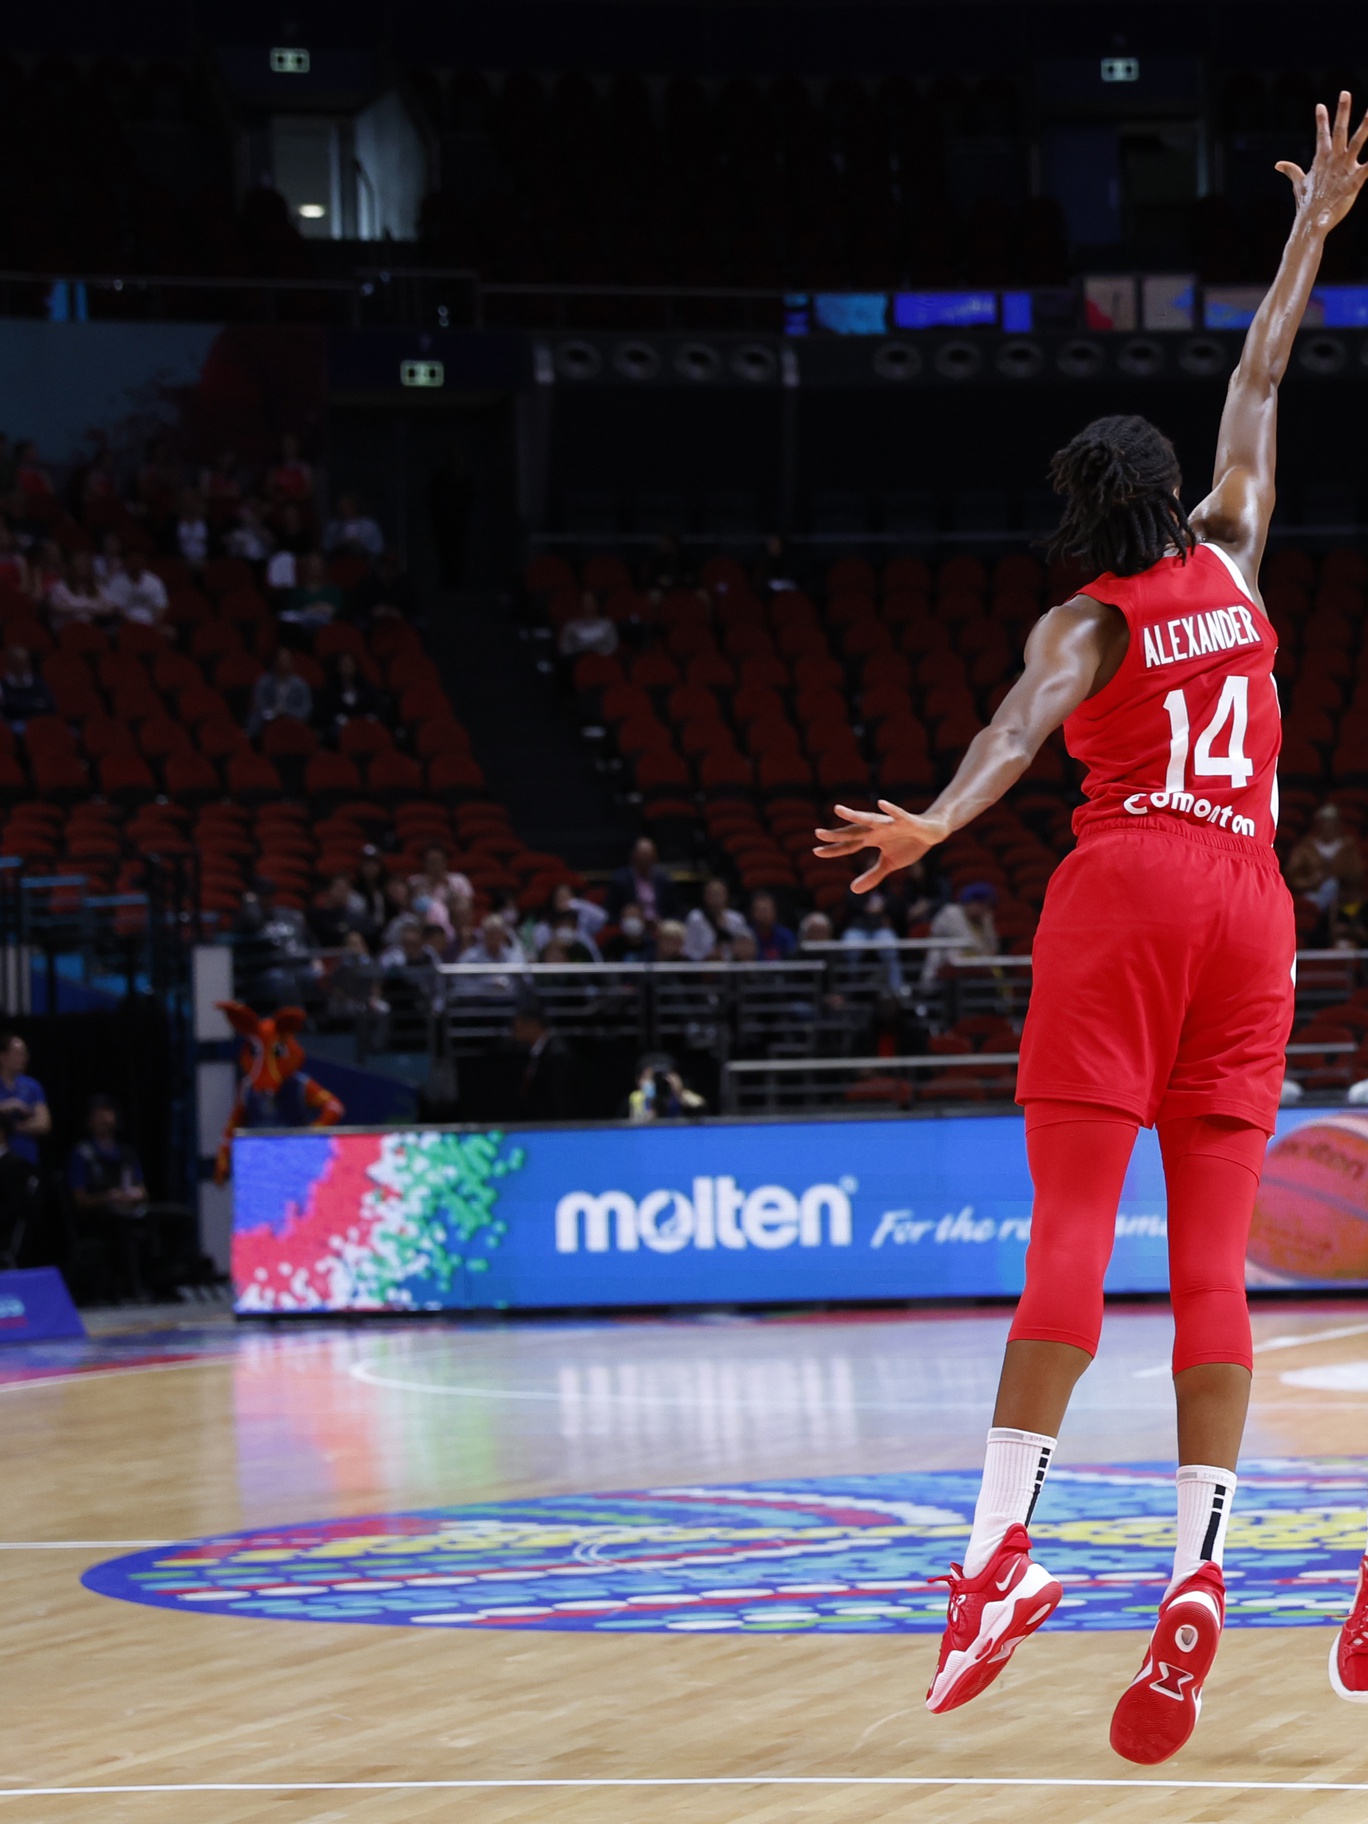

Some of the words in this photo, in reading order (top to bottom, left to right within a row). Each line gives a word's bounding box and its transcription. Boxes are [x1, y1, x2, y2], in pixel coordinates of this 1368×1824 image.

[1143, 604, 1261, 669] ALEXANDER
[1162, 675, 1254, 794] 14
[555, 1175, 854, 1253] molten
[869, 1208, 935, 1249] For
[934, 1205, 996, 1243] the
